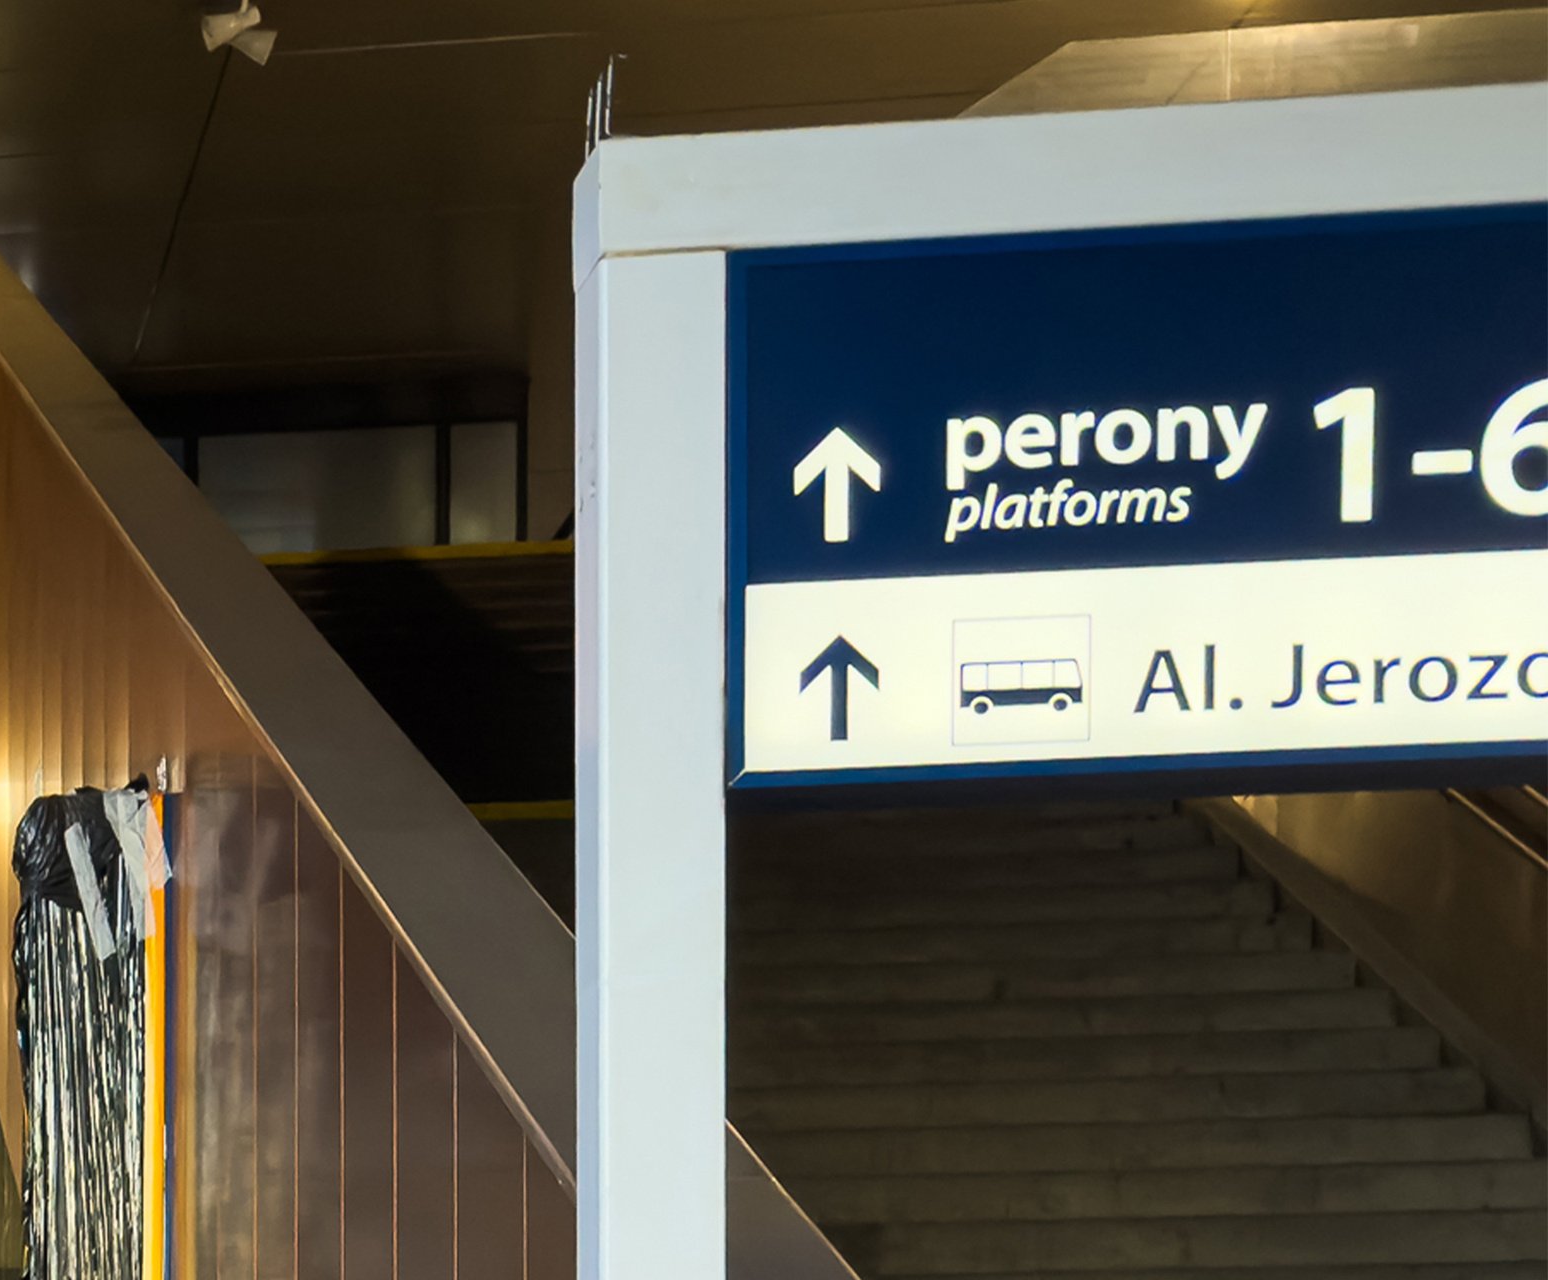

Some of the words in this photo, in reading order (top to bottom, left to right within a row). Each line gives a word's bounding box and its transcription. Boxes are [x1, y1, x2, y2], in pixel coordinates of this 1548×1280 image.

[946, 402, 1268, 491] perony
[944, 478, 1192, 543] platforms
[1133, 643, 1244, 714] Al.
